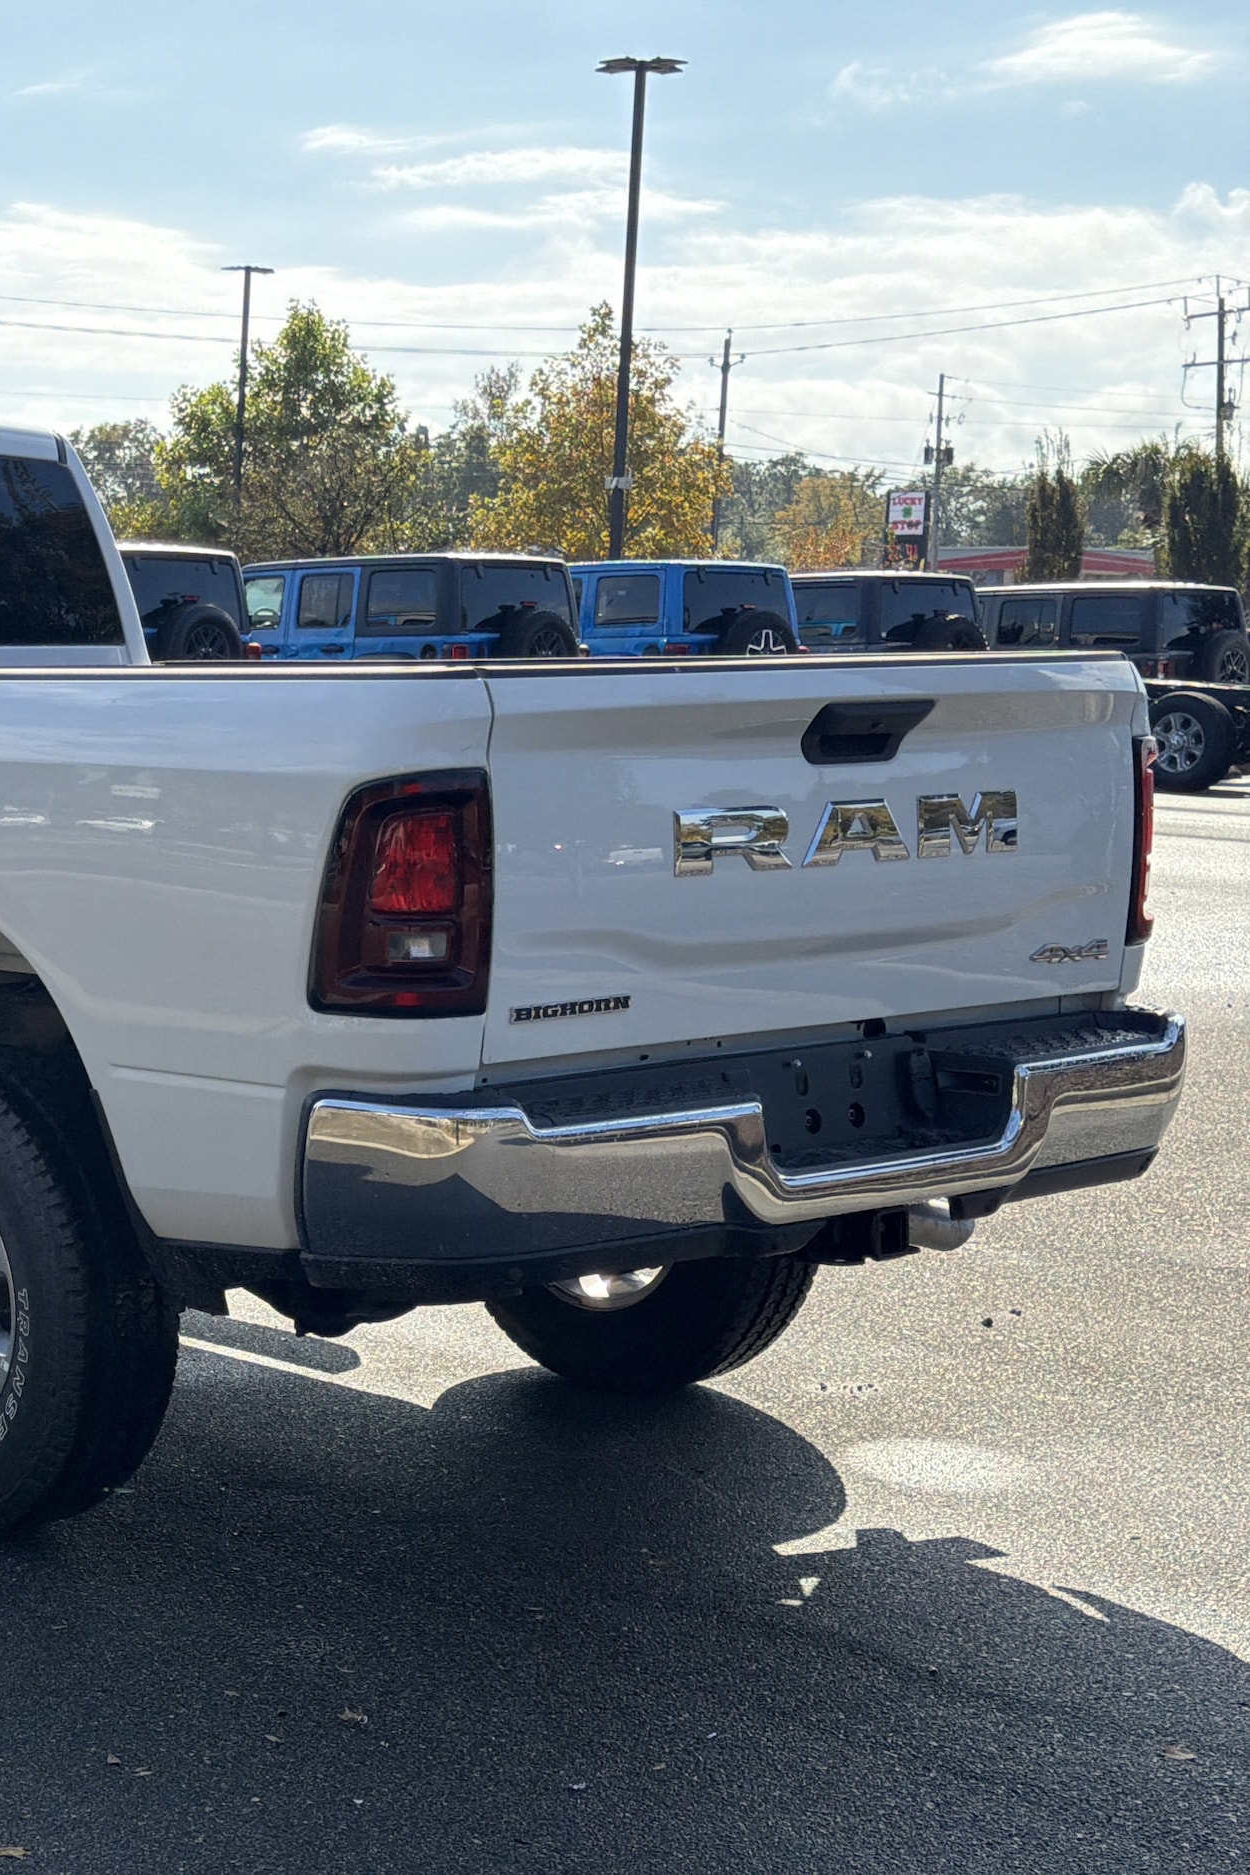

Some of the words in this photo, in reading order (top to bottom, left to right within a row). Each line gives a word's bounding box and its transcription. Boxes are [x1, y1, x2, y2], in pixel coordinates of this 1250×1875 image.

[892, 497, 923, 506] LUCKY
[891, 520, 922, 530] STOP
[673, 791, 1018, 877] RAM
[512, 995, 631, 1023] BIGHORN
